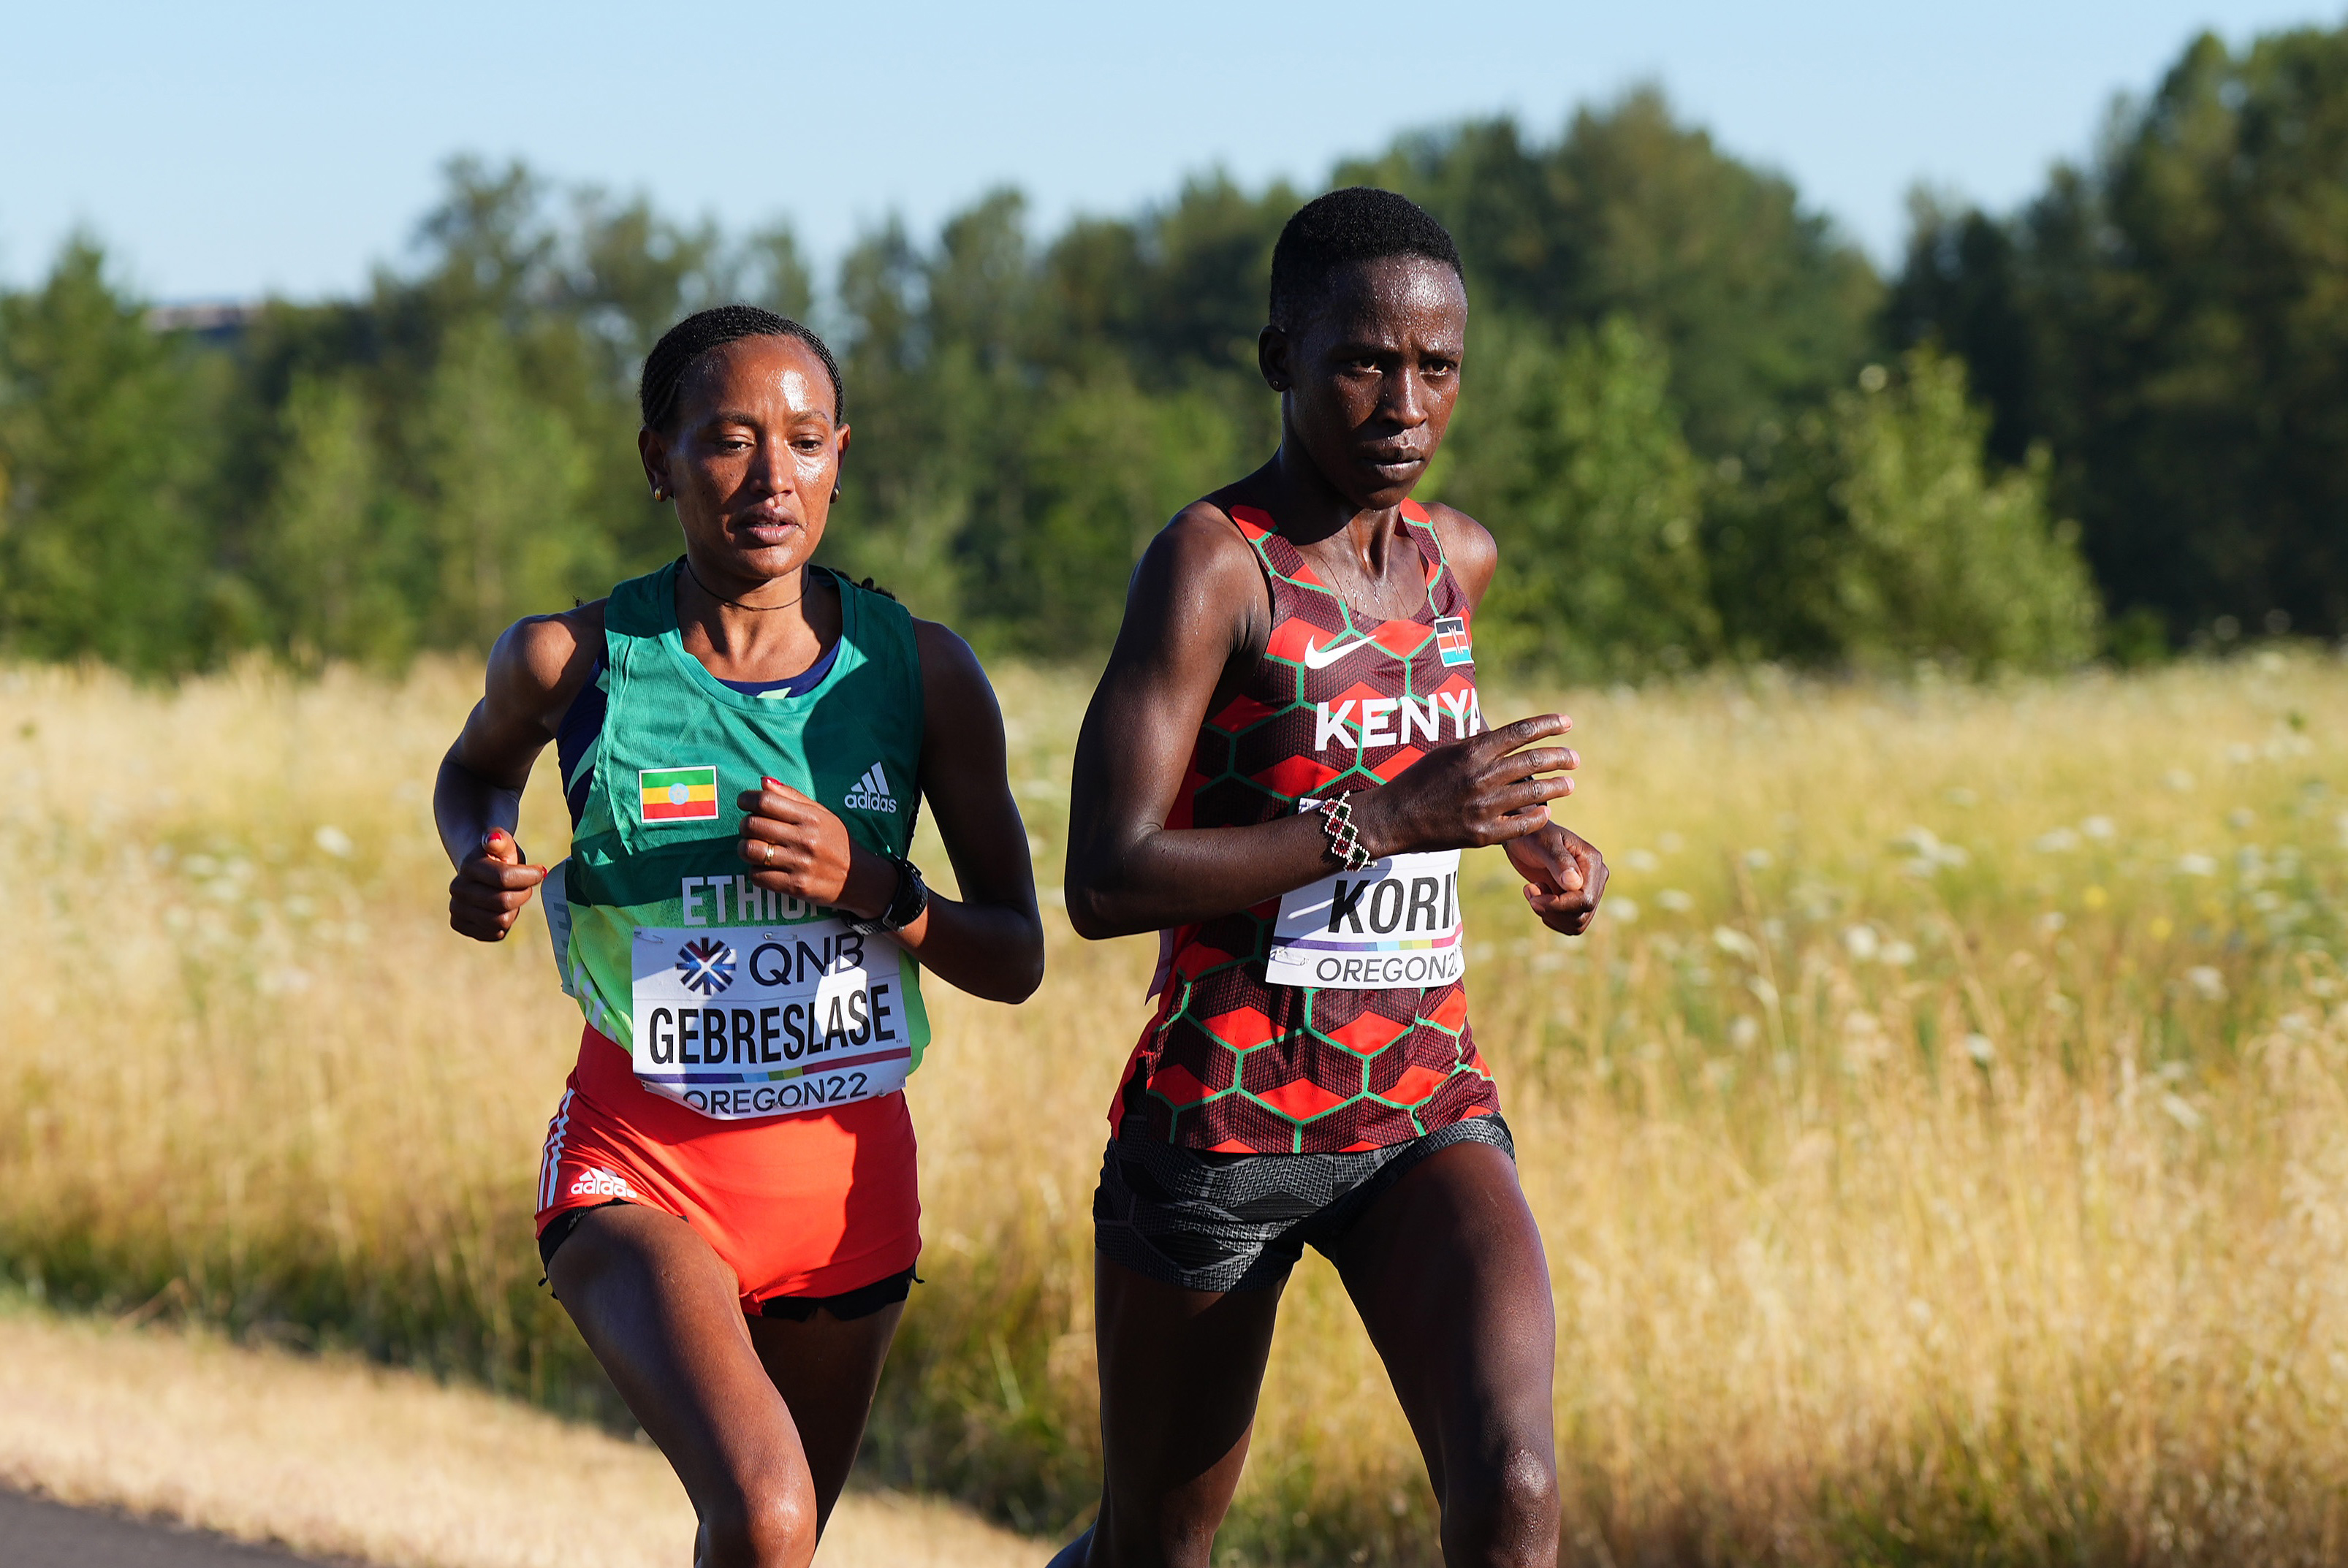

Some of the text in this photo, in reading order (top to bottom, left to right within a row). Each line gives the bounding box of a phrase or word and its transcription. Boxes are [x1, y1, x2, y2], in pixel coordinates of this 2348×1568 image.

[844, 791, 897, 813] adidas
[681, 875, 838, 925] ETHIO
[1328, 870, 1457, 934] KORI
[748, 932, 865, 987] QNB
[1316, 951, 1458, 983] OREGON2
[649, 983, 896, 1065] GEBRESLASE
[683, 1072, 868, 1115] OREGON22
[570, 1178, 637, 1199] adidas
